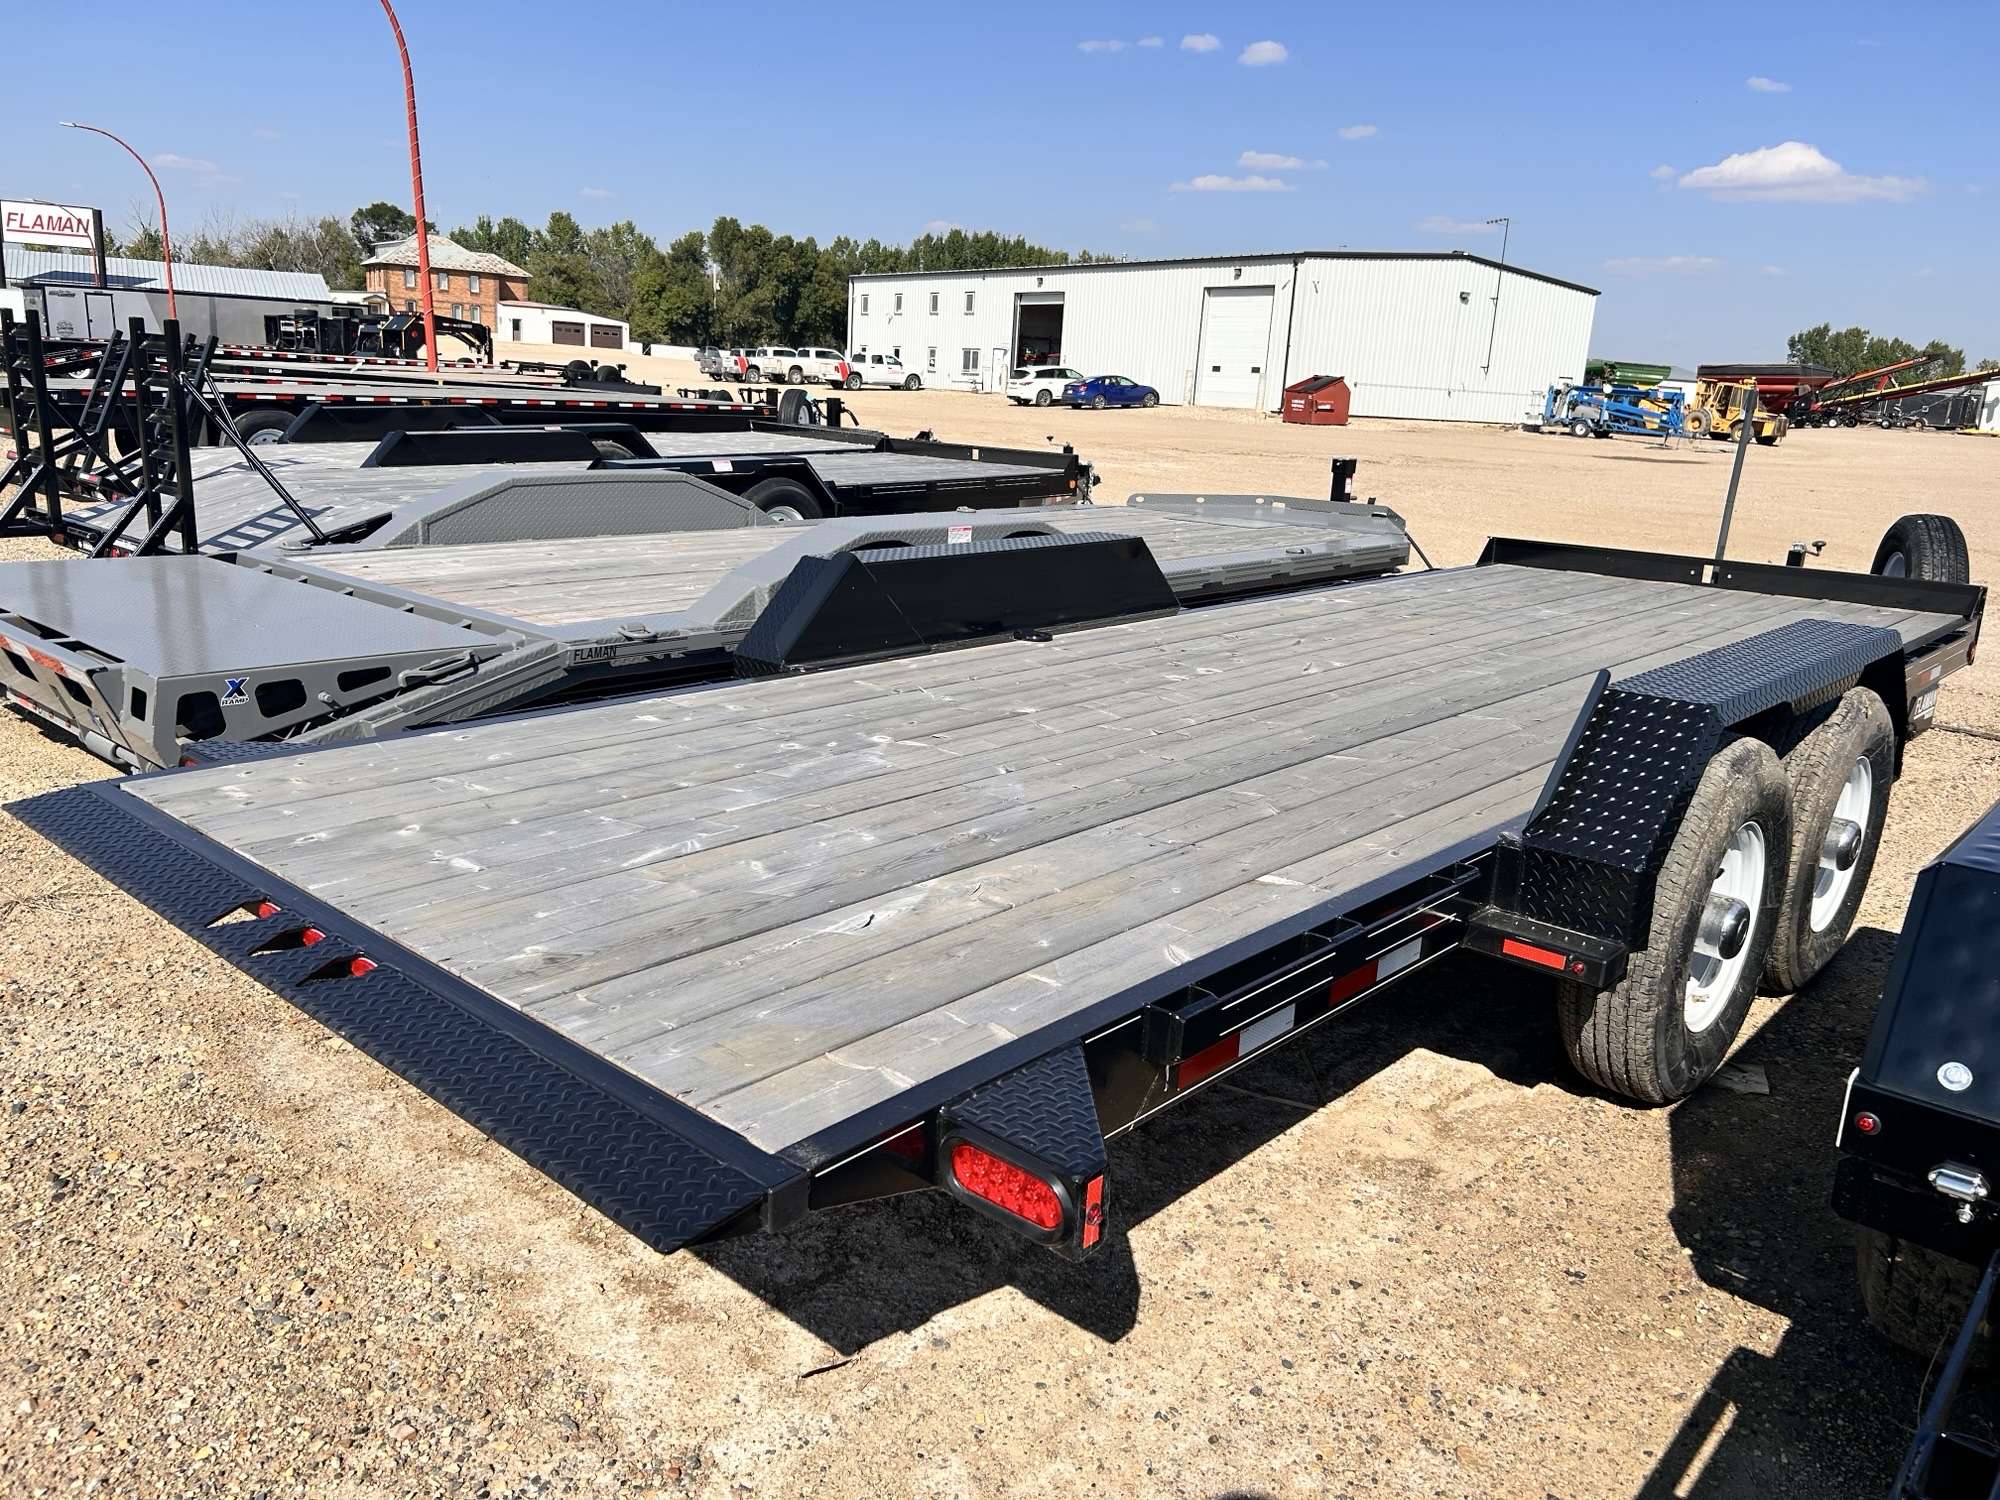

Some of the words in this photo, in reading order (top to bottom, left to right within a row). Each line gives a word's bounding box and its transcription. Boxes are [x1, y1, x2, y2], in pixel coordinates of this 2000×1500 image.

[6, 212, 90, 233] FLAMAN
[574, 644, 617, 661] FLAMAN
[224, 677, 249, 698] X
